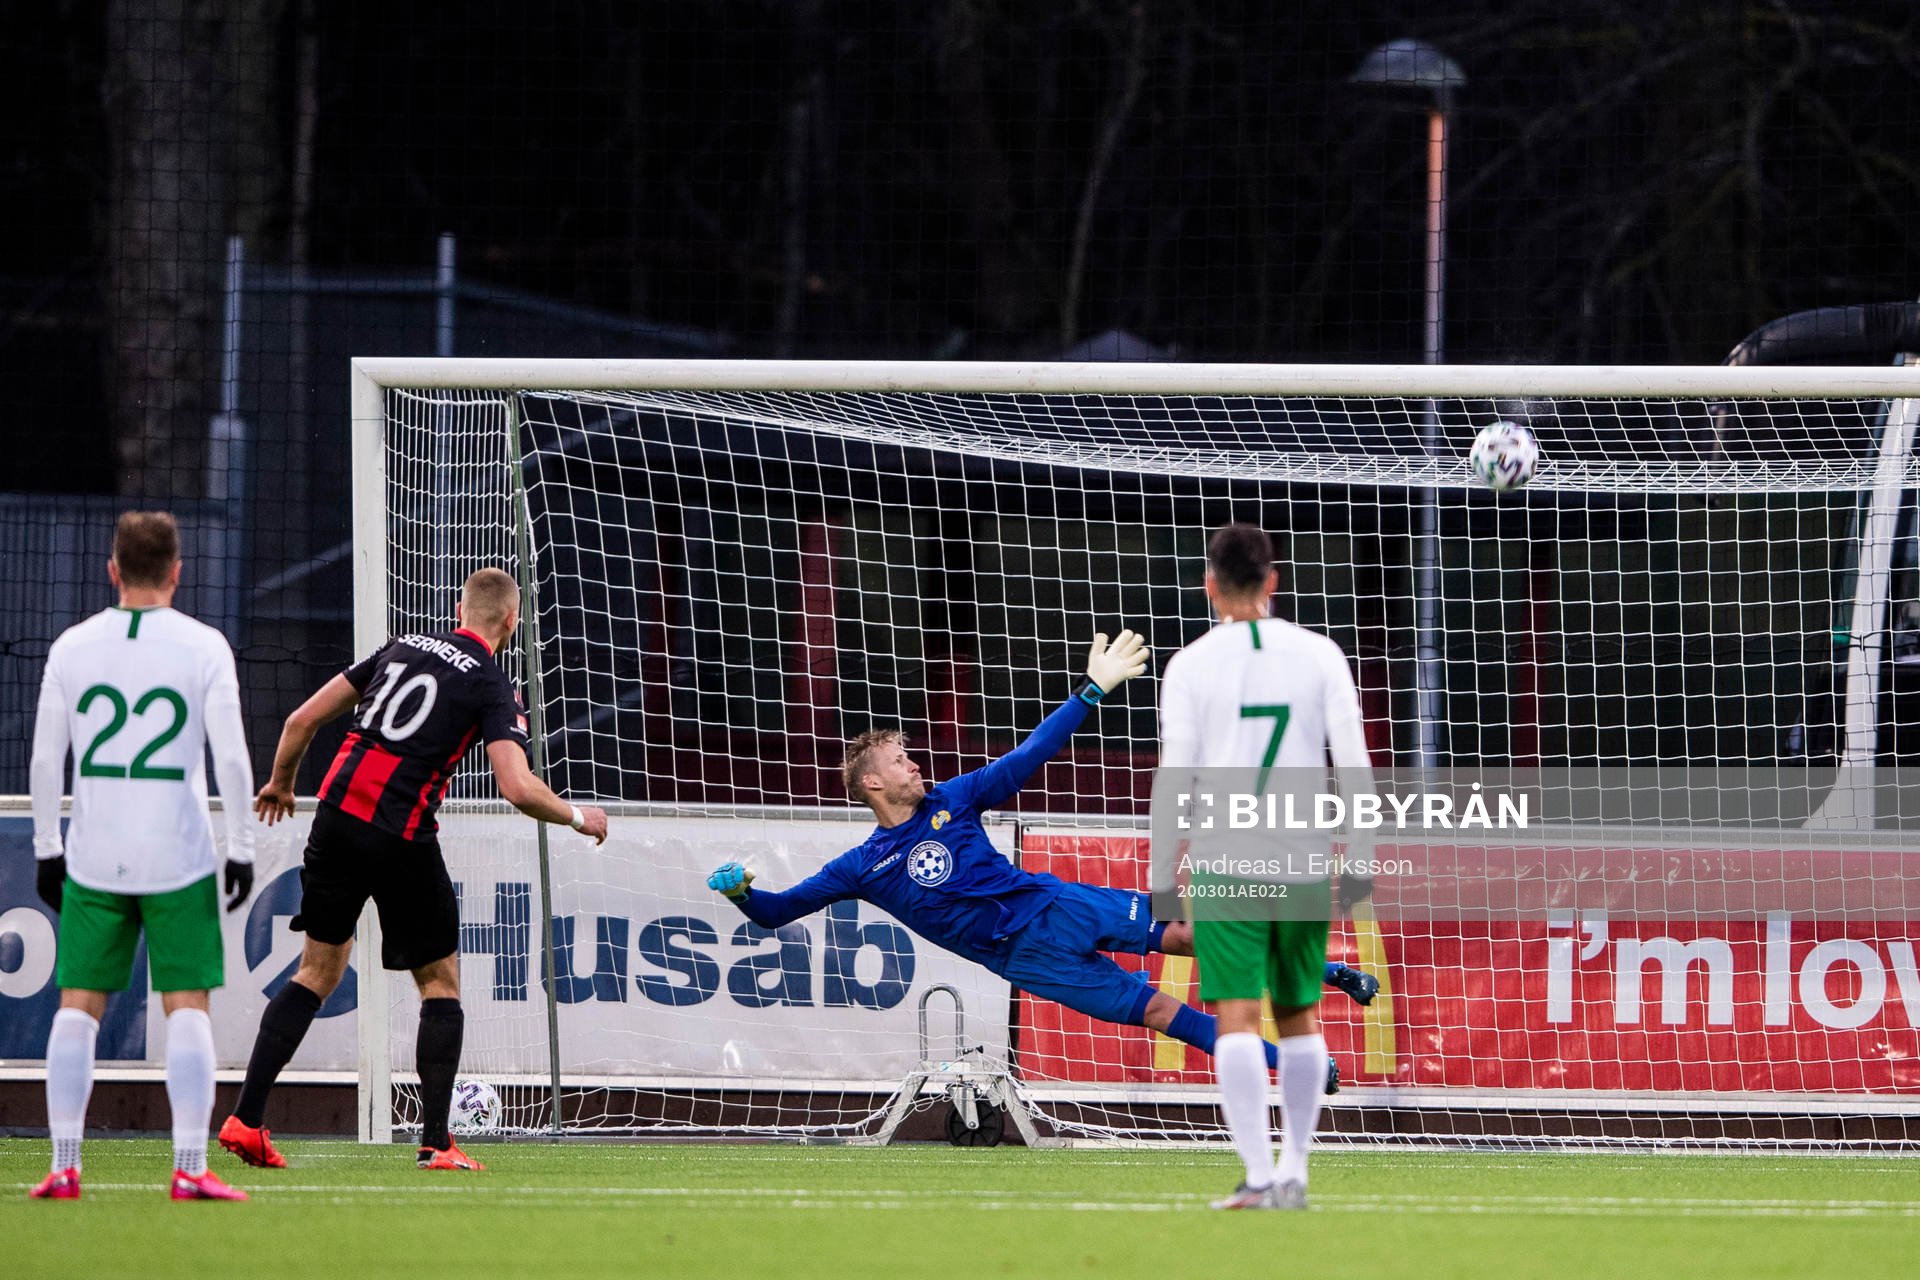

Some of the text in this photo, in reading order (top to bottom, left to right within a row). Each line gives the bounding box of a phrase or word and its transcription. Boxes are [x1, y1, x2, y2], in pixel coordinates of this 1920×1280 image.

[398, 634, 477, 673] SERNEKE
[77, 683, 188, 781] 22
[361, 662, 438, 741] 10
[1240, 705, 1291, 797] 7
[452, 882, 916, 1011] Husab
